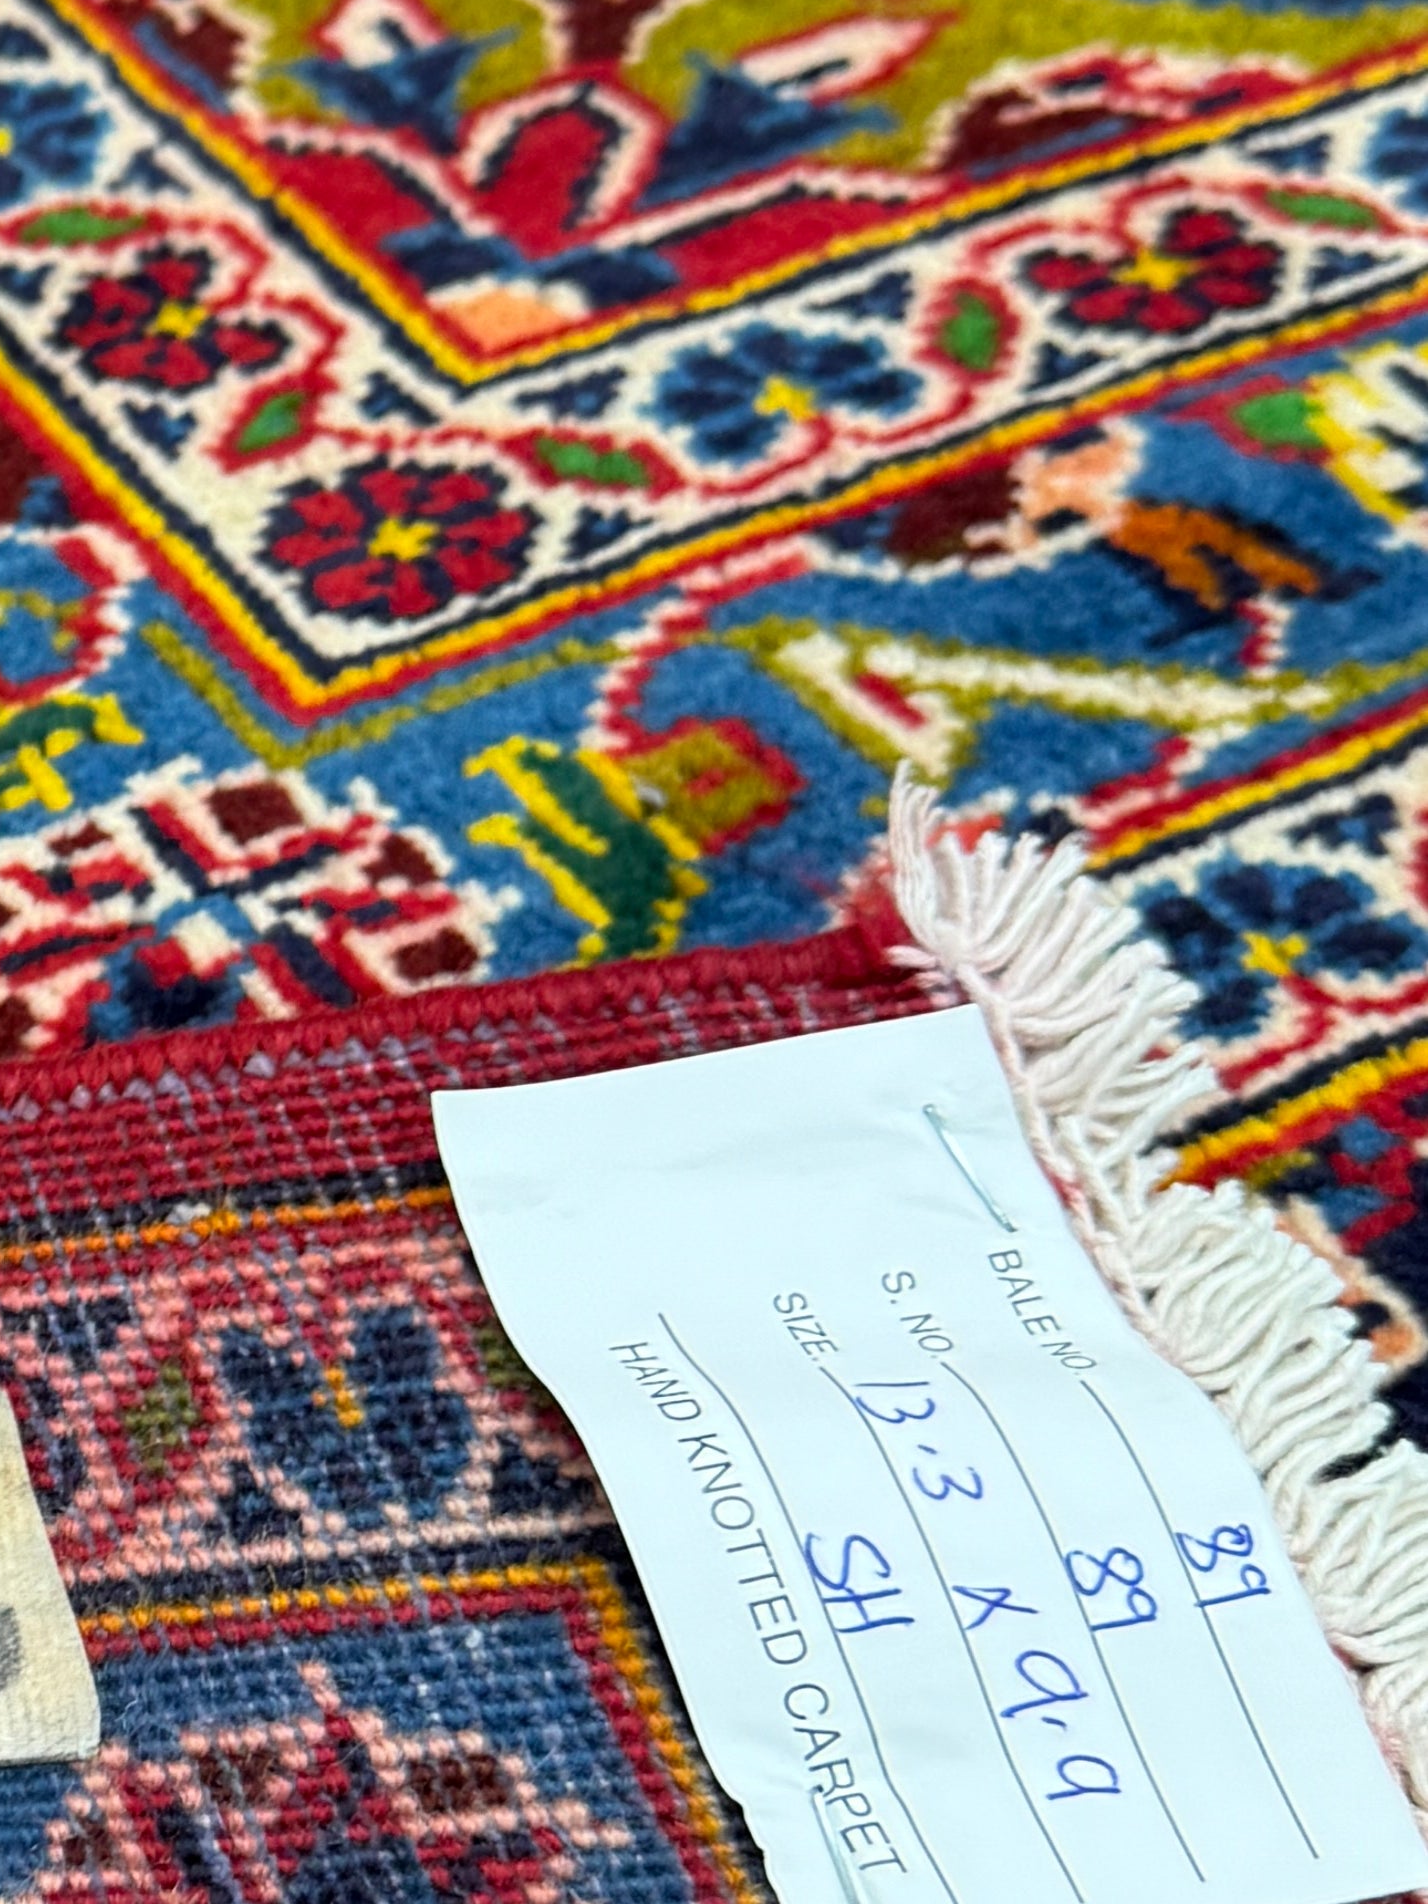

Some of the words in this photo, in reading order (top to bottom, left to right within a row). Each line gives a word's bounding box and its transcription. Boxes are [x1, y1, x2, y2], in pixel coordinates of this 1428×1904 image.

[608, 1341, 702, 1423] HAND
[678, 1432, 809, 1666] KNOTTED
[783, 1683, 908, 1874] CARPET
[804, 1533, 915, 1634] SH
[881, 1270, 917, 1305] S.
[900, 1312, 954, 1359] NO.
[1064, 1546, 1157, 1631] 89
[988, 1248, 1061, 1337] BALE
[1041, 1339, 1098, 1376] NO.
[1175, 1523, 1271, 1608] 89
